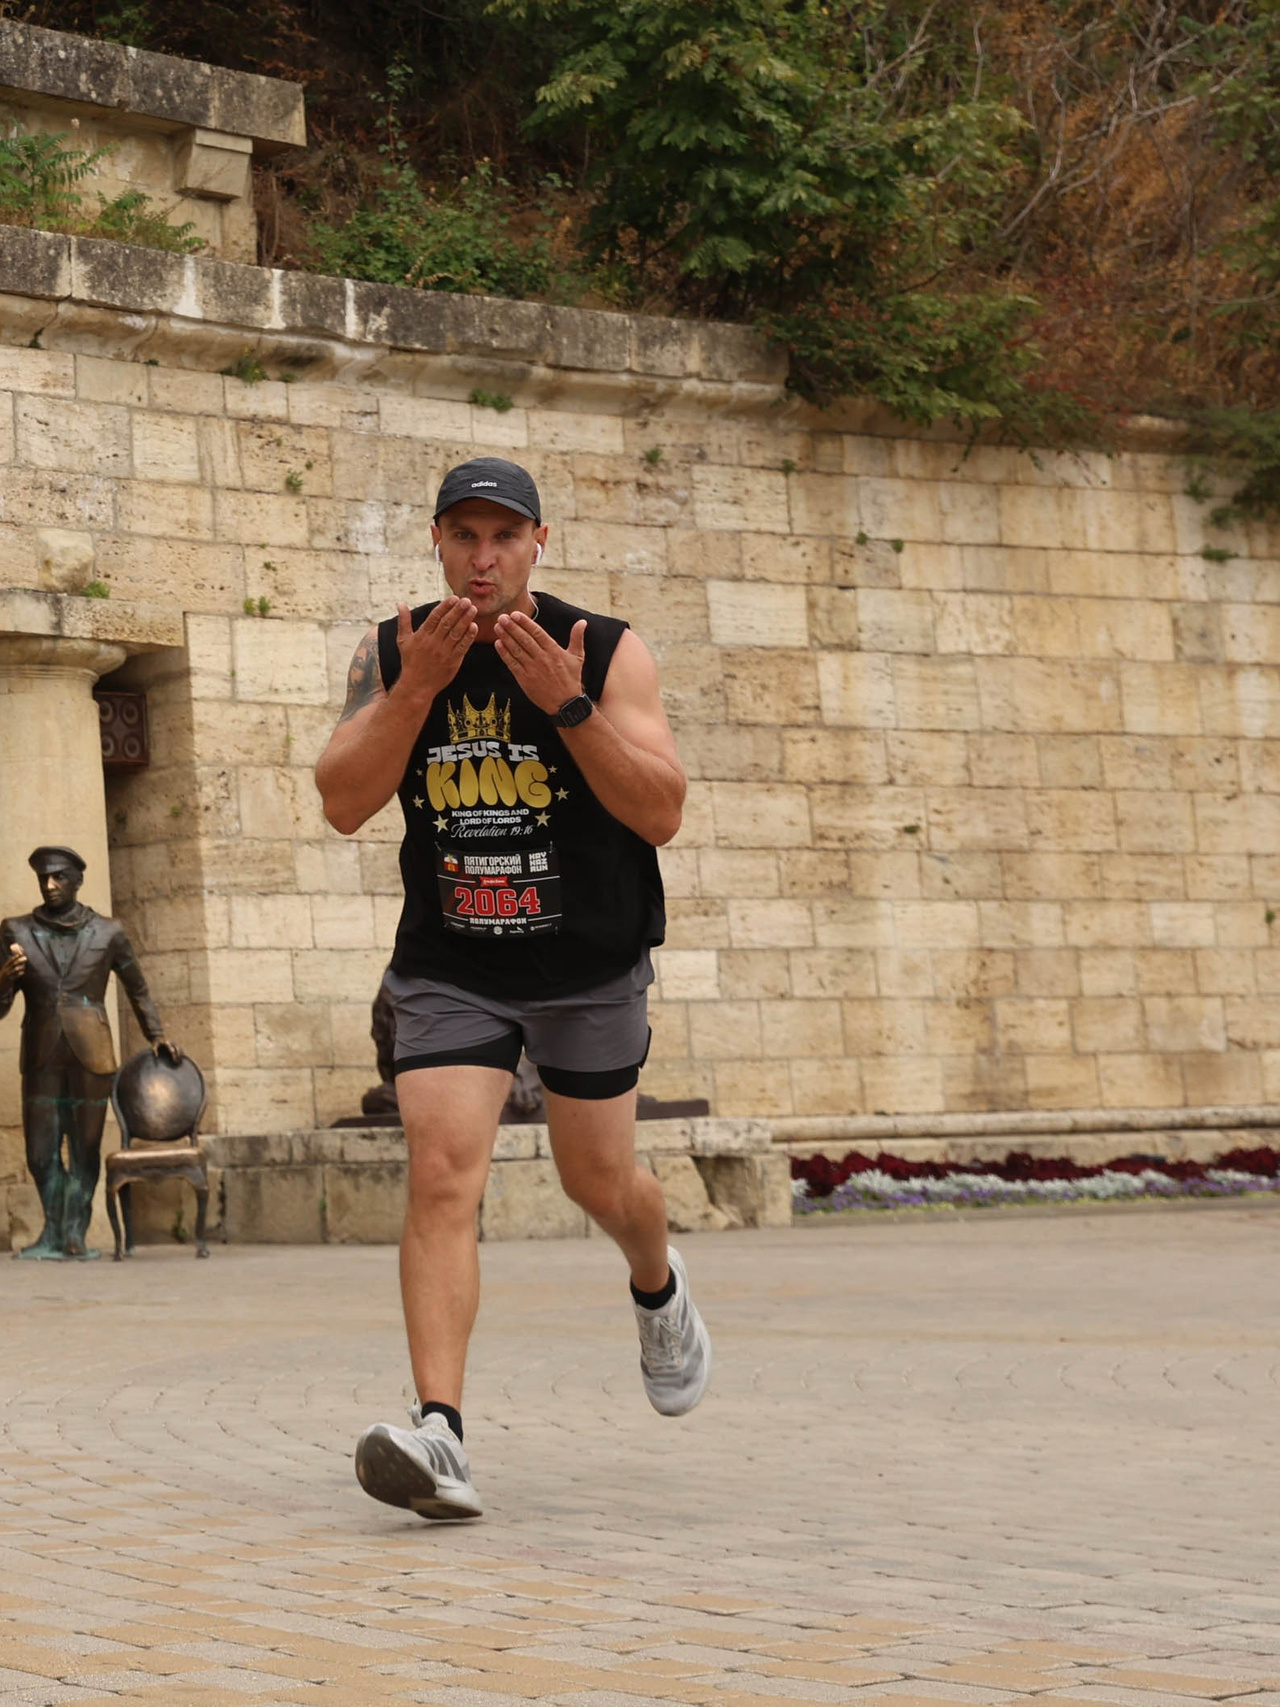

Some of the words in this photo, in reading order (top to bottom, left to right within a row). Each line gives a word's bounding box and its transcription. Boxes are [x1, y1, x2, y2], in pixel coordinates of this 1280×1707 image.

[426, 740, 502, 765] JESUS
[507, 743, 540, 762] IS
[426, 756, 552, 812] KING
[492, 816, 522, 824] LORDS
[451, 824, 508, 838] Revelation
[510, 825, 534, 836] 19:16
[464, 854, 521, 866] ПЯТИГОРСКИЙ
[465, 865, 522, 875] ПОЛУМАРАФОН
[454, 886, 541, 916] 2064
[469, 917, 527, 925] ПОЛУМАРАФОН
